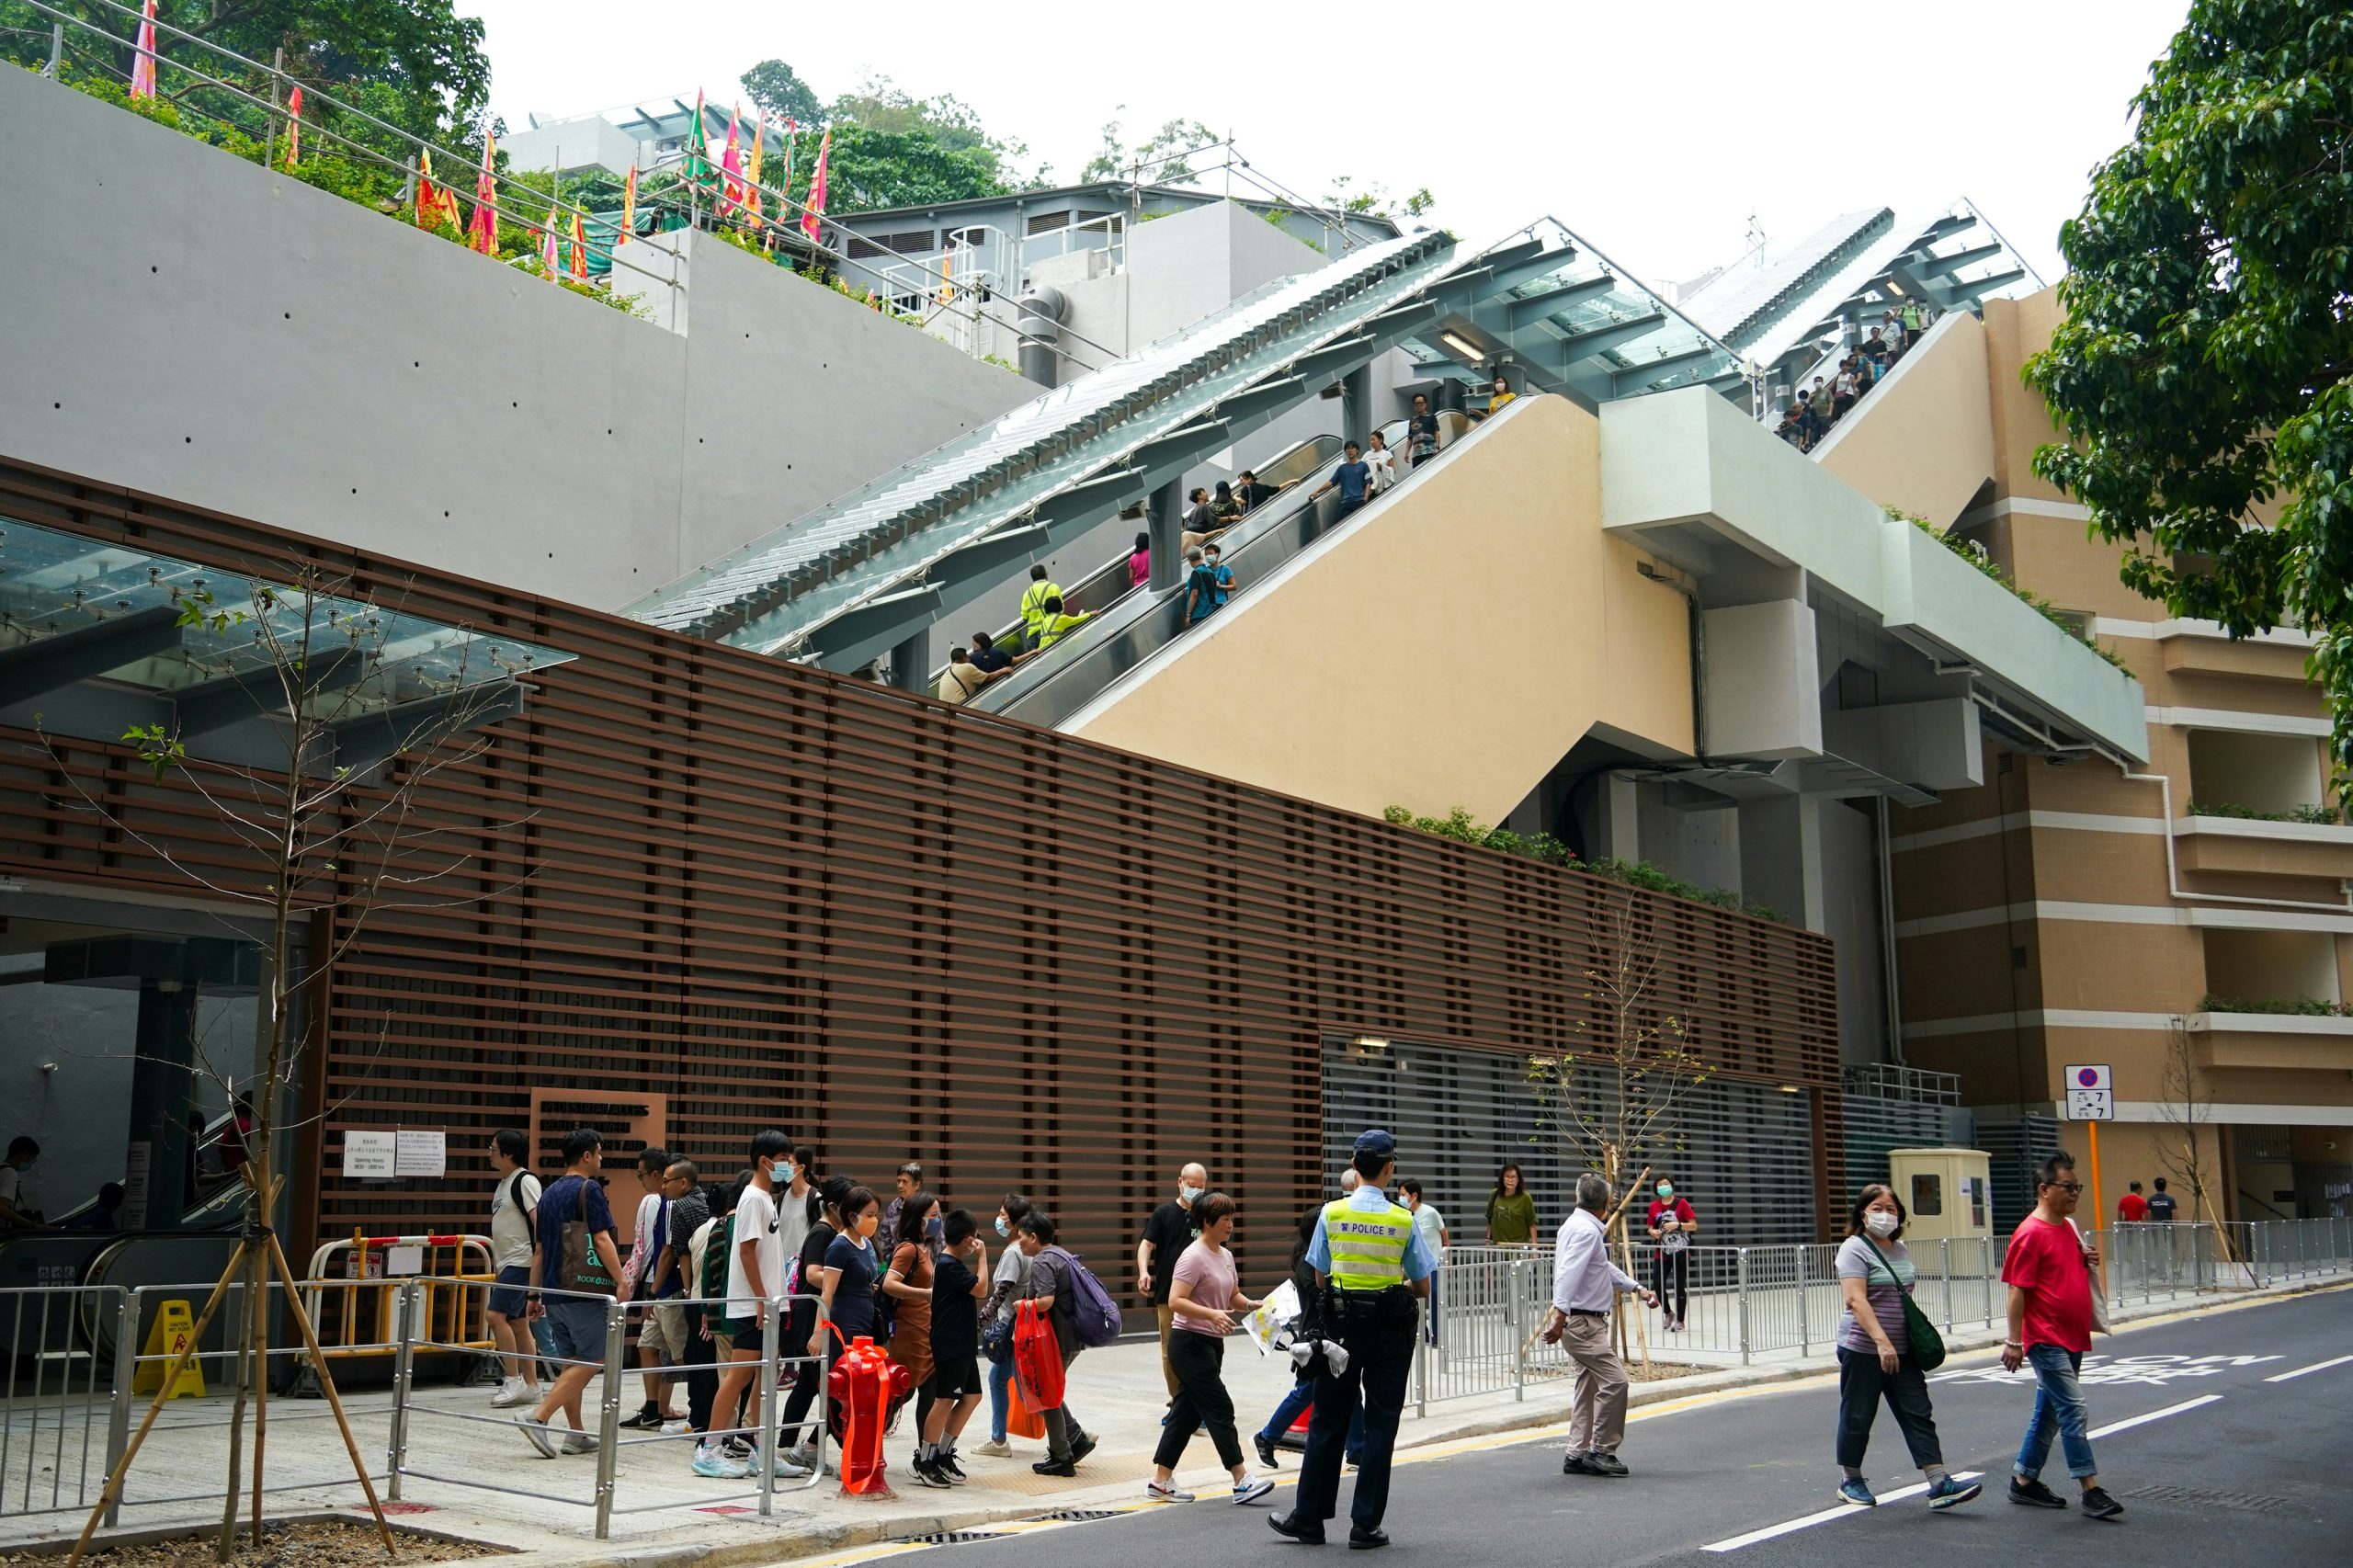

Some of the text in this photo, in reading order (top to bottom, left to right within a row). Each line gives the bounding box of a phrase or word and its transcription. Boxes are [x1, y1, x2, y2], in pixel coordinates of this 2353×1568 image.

[2096, 1092, 2103, 1102] 7
[2097, 1108, 2104, 1118] 7
[1352, 1223, 1384, 1235] POLICE
